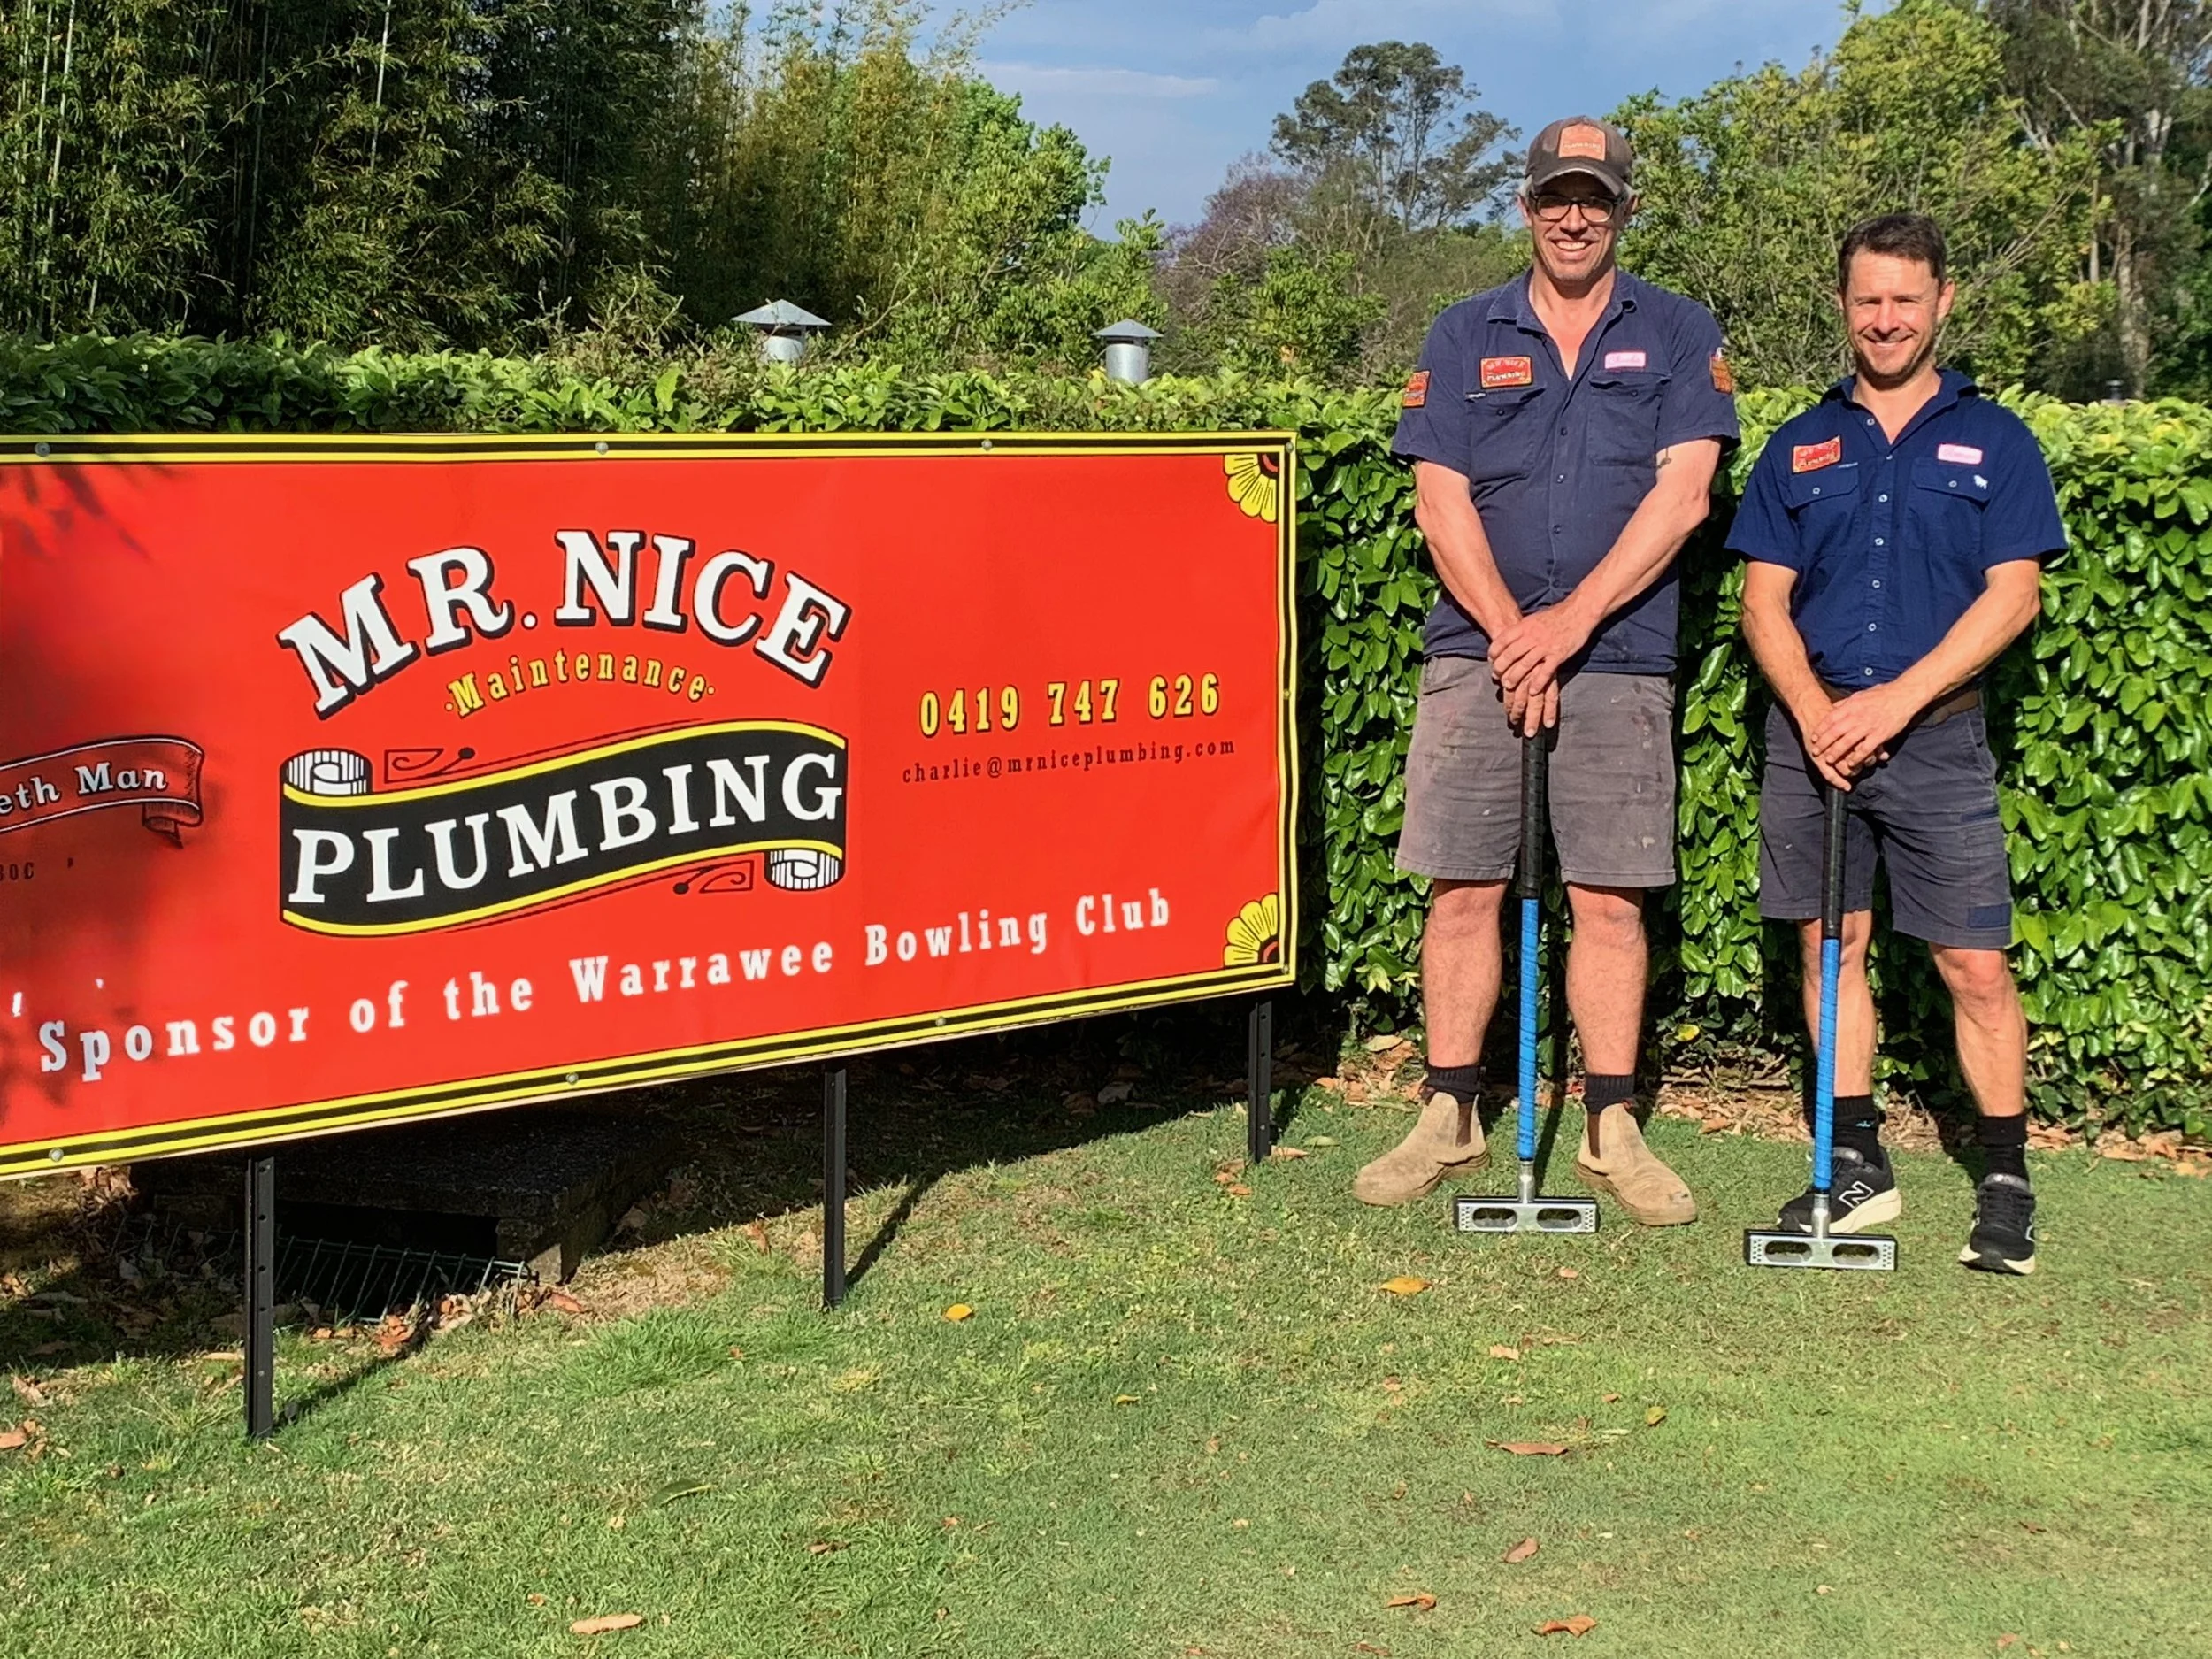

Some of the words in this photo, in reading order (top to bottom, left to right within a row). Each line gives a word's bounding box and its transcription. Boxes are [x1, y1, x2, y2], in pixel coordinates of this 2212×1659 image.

[276, 546, 538, 721] MR.
[554, 529, 852, 688] NICE
[447, 647, 705, 718] Maintenance
[919, 685, 1020, 739] 0419
[1047, 678, 1120, 727] 747
[1148, 672, 1220, 718] 626
[74, 762, 166, 795] Man
[902, 739, 1235, 784] charlie@mrniceplumbing.com
[288, 751, 842, 904] PLUMBING
[39, 1007, 309, 1082] Sponsor
[350, 980, 409, 1033] of
[444, 971, 533, 1020] the
[569, 941, 833, 1003] Warrawee
[864, 910, 1048, 966] Bowling
[1075, 888, 1170, 936] Club
